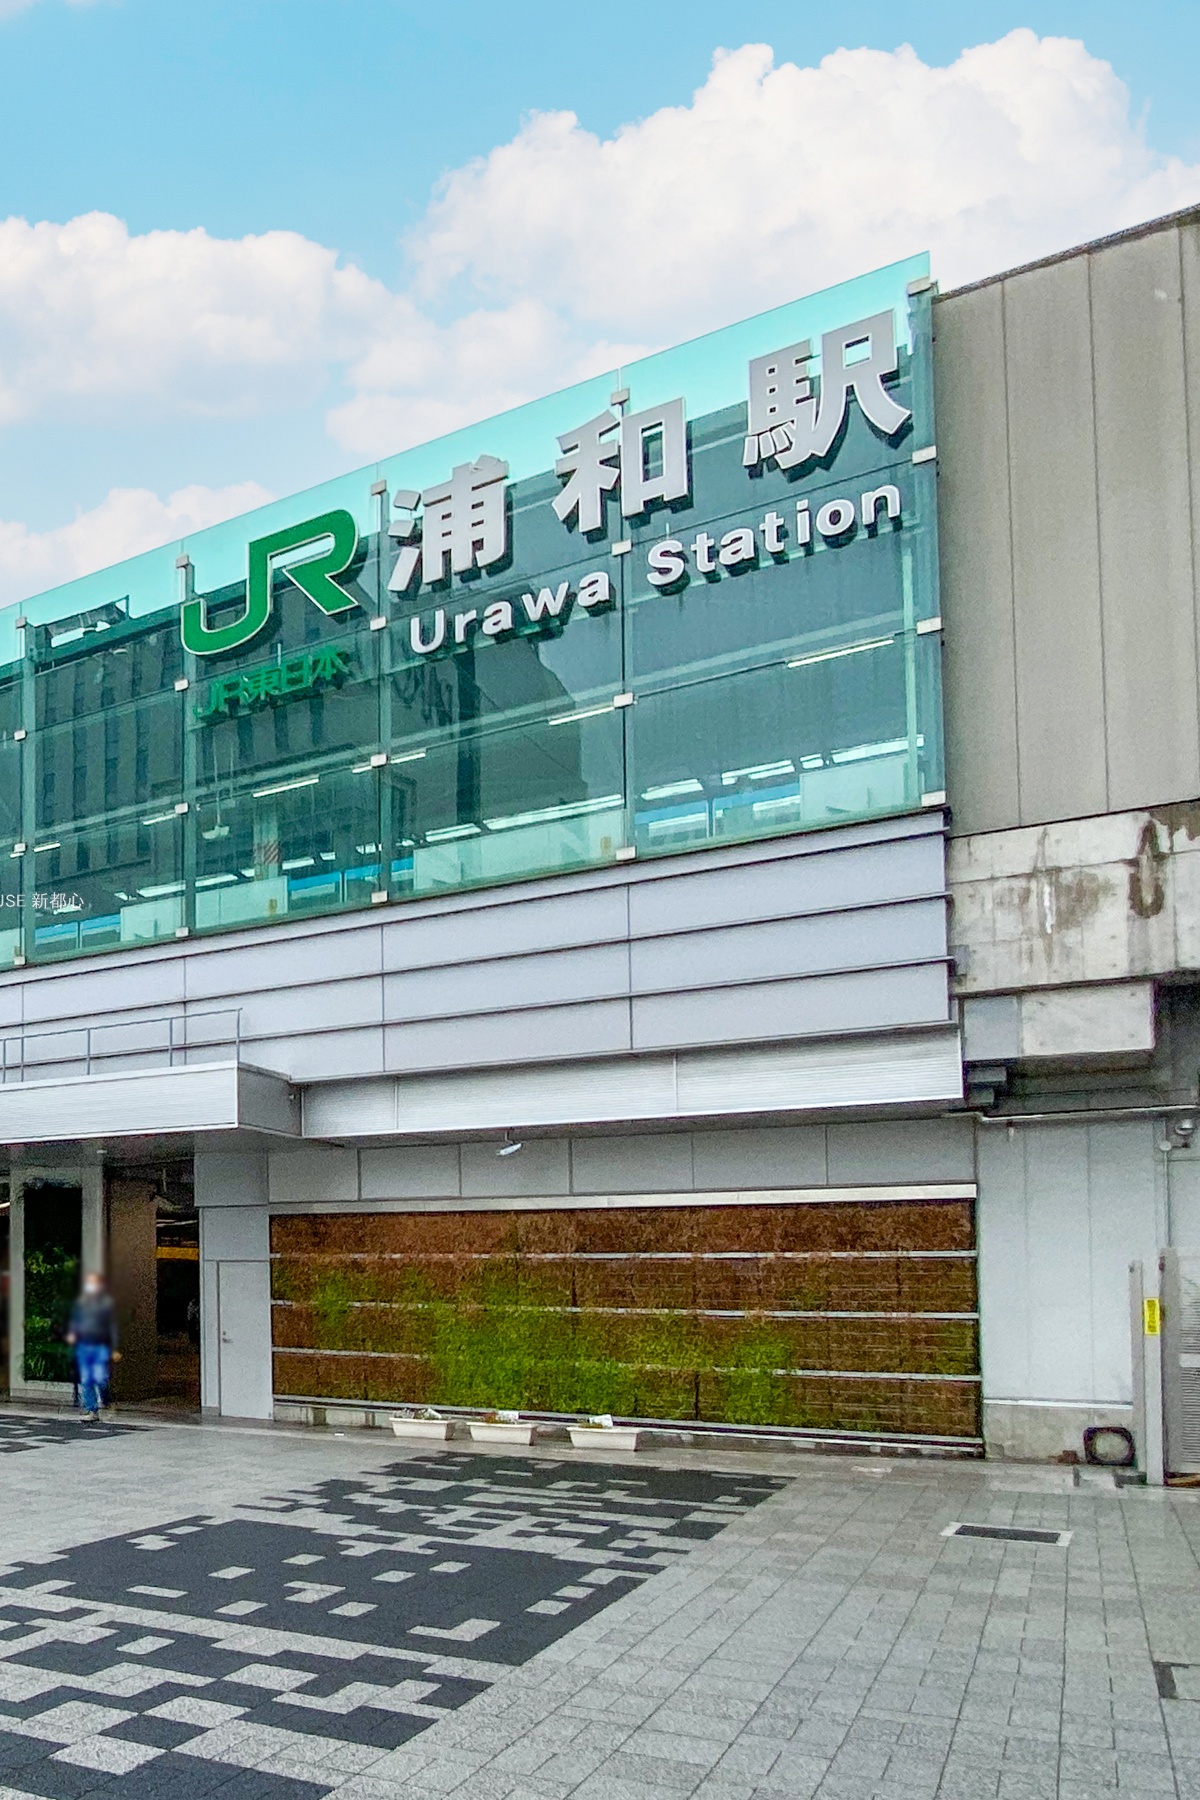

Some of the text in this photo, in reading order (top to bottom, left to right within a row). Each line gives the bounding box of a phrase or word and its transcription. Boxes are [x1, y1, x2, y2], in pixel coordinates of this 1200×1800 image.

[388, 309, 912, 593] 浦和駅
[181, 509, 359, 655] JR
[409, 482, 901, 655] Urawa Station
[194, 645, 351, 718] JR東日本
